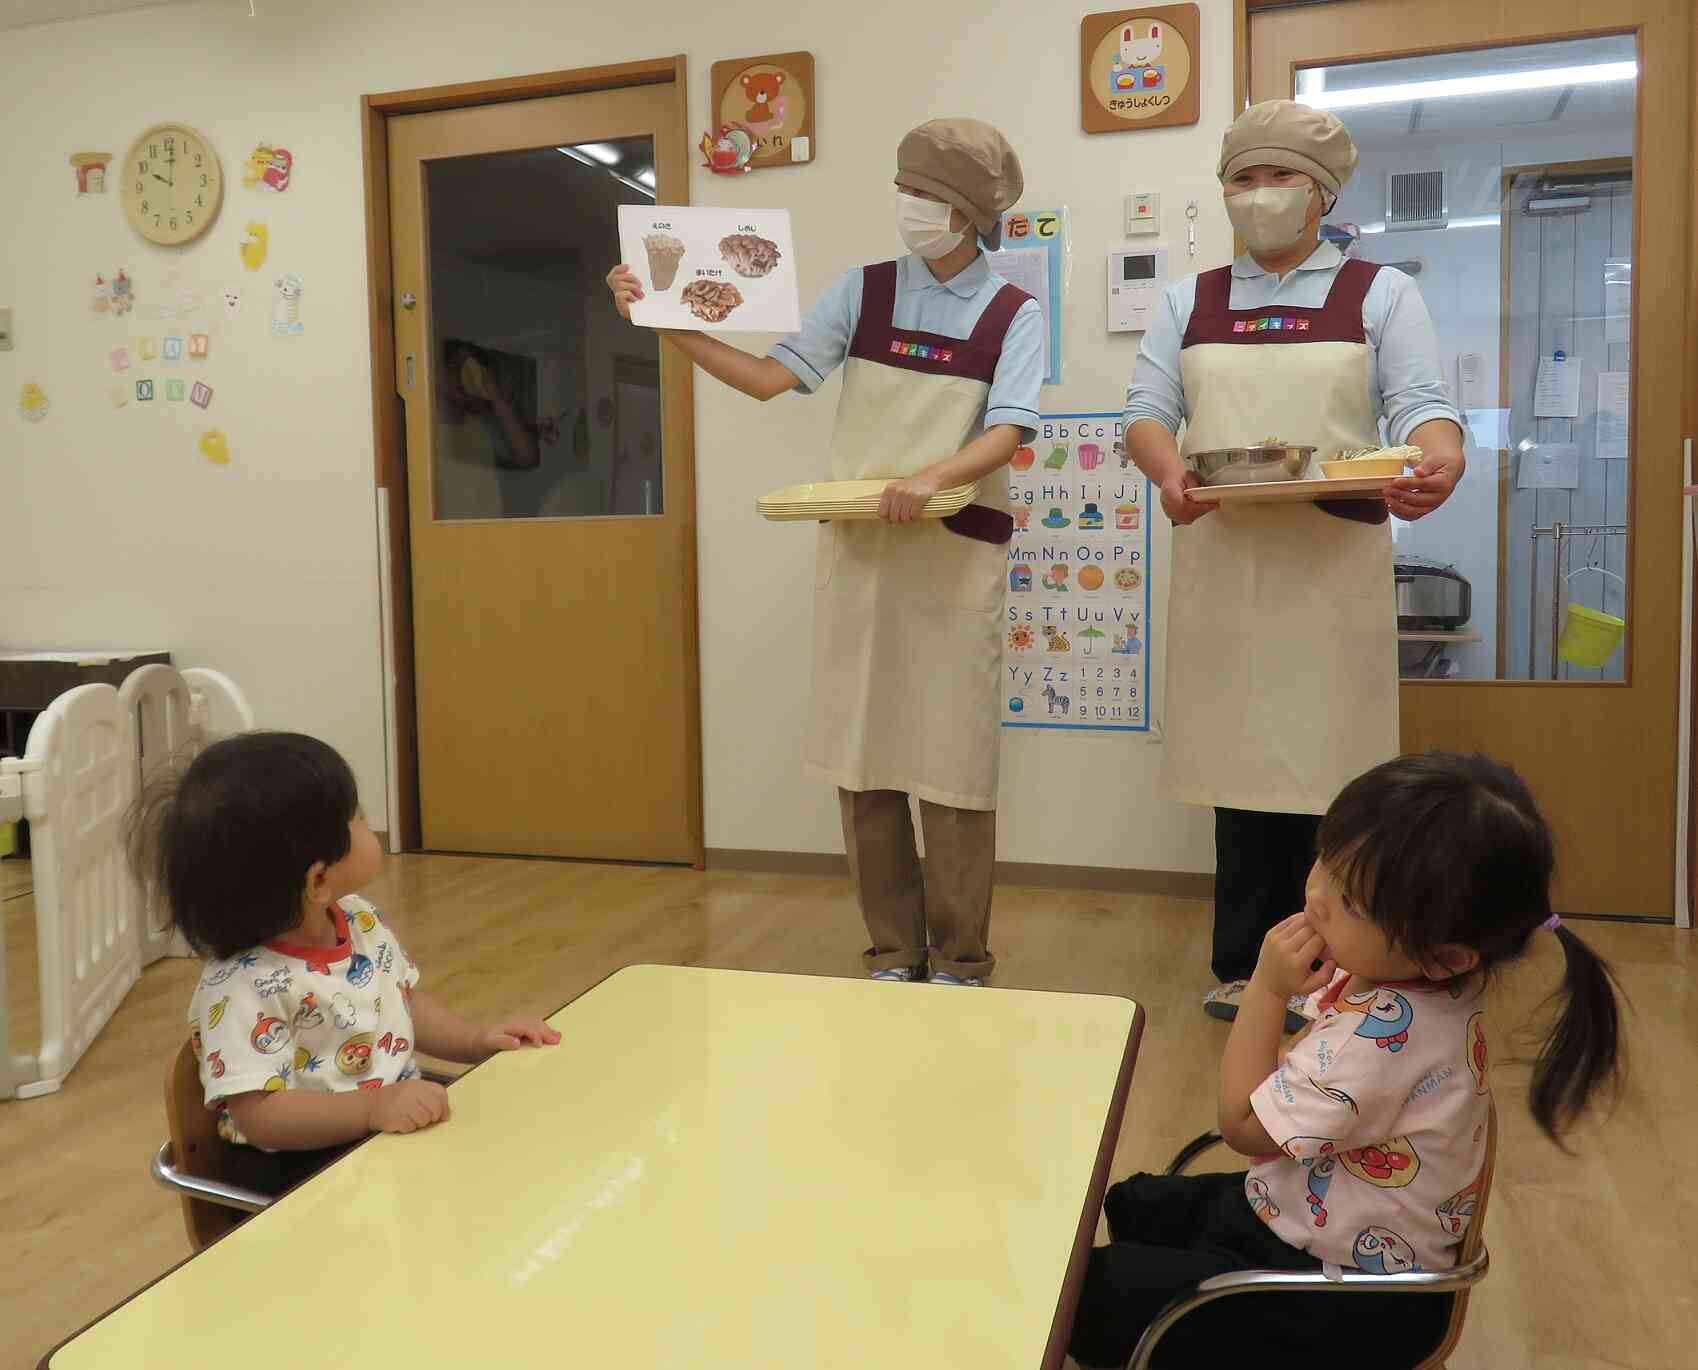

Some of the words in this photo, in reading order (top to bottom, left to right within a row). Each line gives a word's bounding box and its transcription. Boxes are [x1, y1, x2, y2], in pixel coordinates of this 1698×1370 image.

[1109, 95, 1170, 111] きゅうしょくしつ
[1080, 667, 1086, 678] 1
[1096, 667, 1104, 678] 2
[1113, 668, 1121, 679] 3
[1129, 669, 1137, 680] 4
[1079, 686, 1087, 697] 5
[1096, 687, 1104, 697] 6
[1113, 687, 1120, 697] 7
[1130, 687, 1137, 698] 8
[1079, 705, 1087, 716] 9
[1095, 706, 1106, 717] 10
[1112, 706, 1121, 717] 11
[1128, 706, 1140, 717] 12
